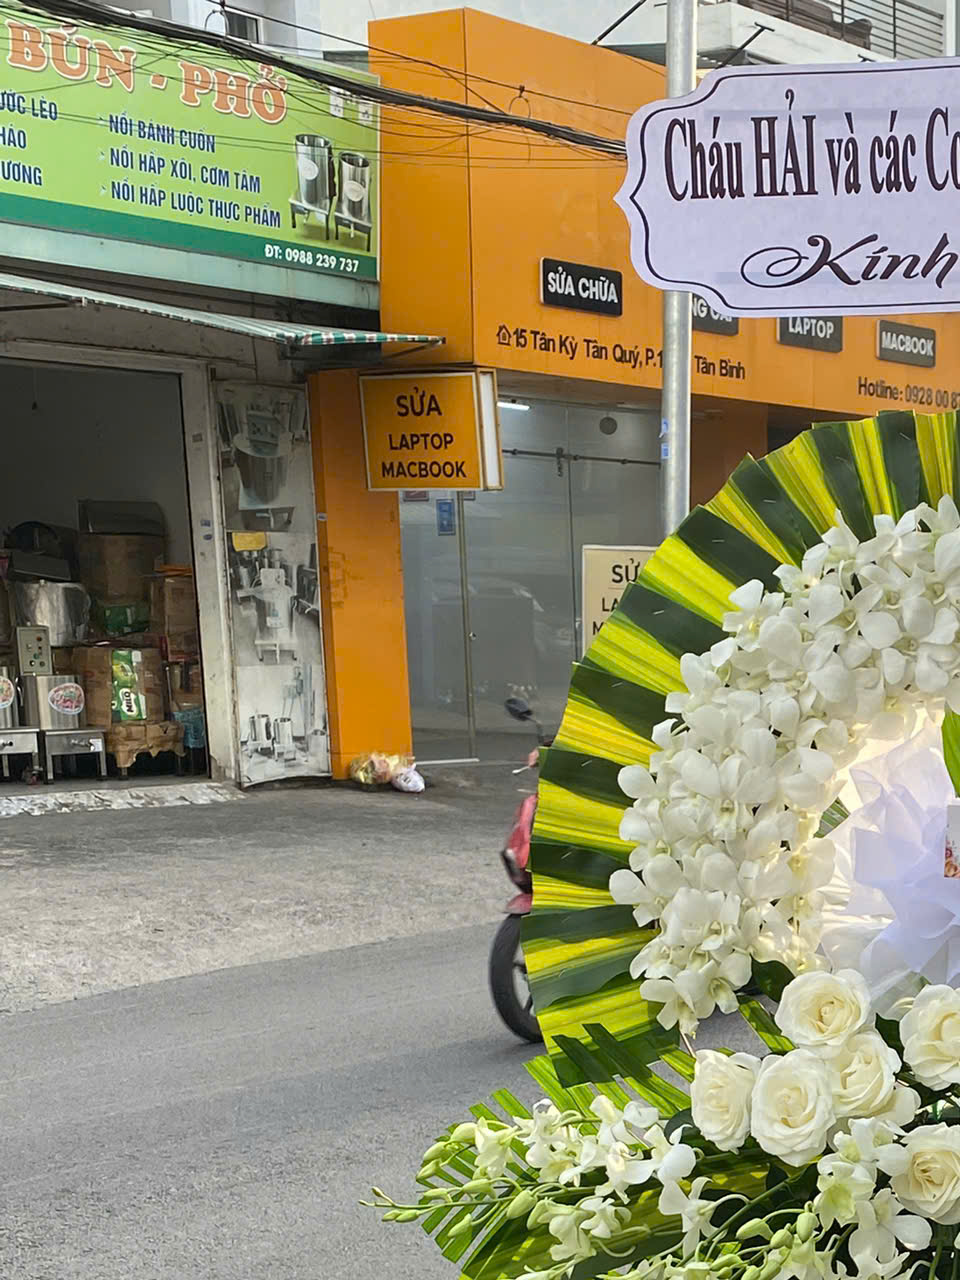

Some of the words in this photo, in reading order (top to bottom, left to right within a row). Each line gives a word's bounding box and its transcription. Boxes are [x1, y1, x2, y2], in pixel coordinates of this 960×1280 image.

[180, 61, 287, 124] PHỞ
[664, 116, 746, 201] Cháu
[751, 89, 818, 197] HẢI
[825, 112, 861, 196] và
[869, 110, 917, 194] các
[201, 165, 229, 188] CƠM
[265, 243, 283, 259] ĐT:
[285, 248, 313, 265] 0988
[316, 253, 337, 269] 239
[339, 257, 359, 272] 737
[741, 233, 958, 289] Kính
[547, 266, 576, 296] SỬA
[578, 276, 619, 303] CHỮA
[788, 316, 834, 339] LAPTOP
[513, 327, 528, 348] 15
[530, 327, 556, 352] Tân
[558, 335, 578, 360] Kỳ
[583, 338, 608, 360] Tân
[612, 343, 643, 369] Quý,
[694, 355, 716, 376] Tân
[719, 359, 746, 380] Bình
[881, 331, 935, 357] MACBOOK
[396, 386, 443, 417] SỬA
[858, 376, 903, 401] Hotline:
[905, 383, 933, 406] 0928
[935, 390, 949, 408] 00
[388, 433, 454, 450] LAPTOP
[381, 461, 467, 478] MACBOOK
[123, 690, 134, 713] MILO
